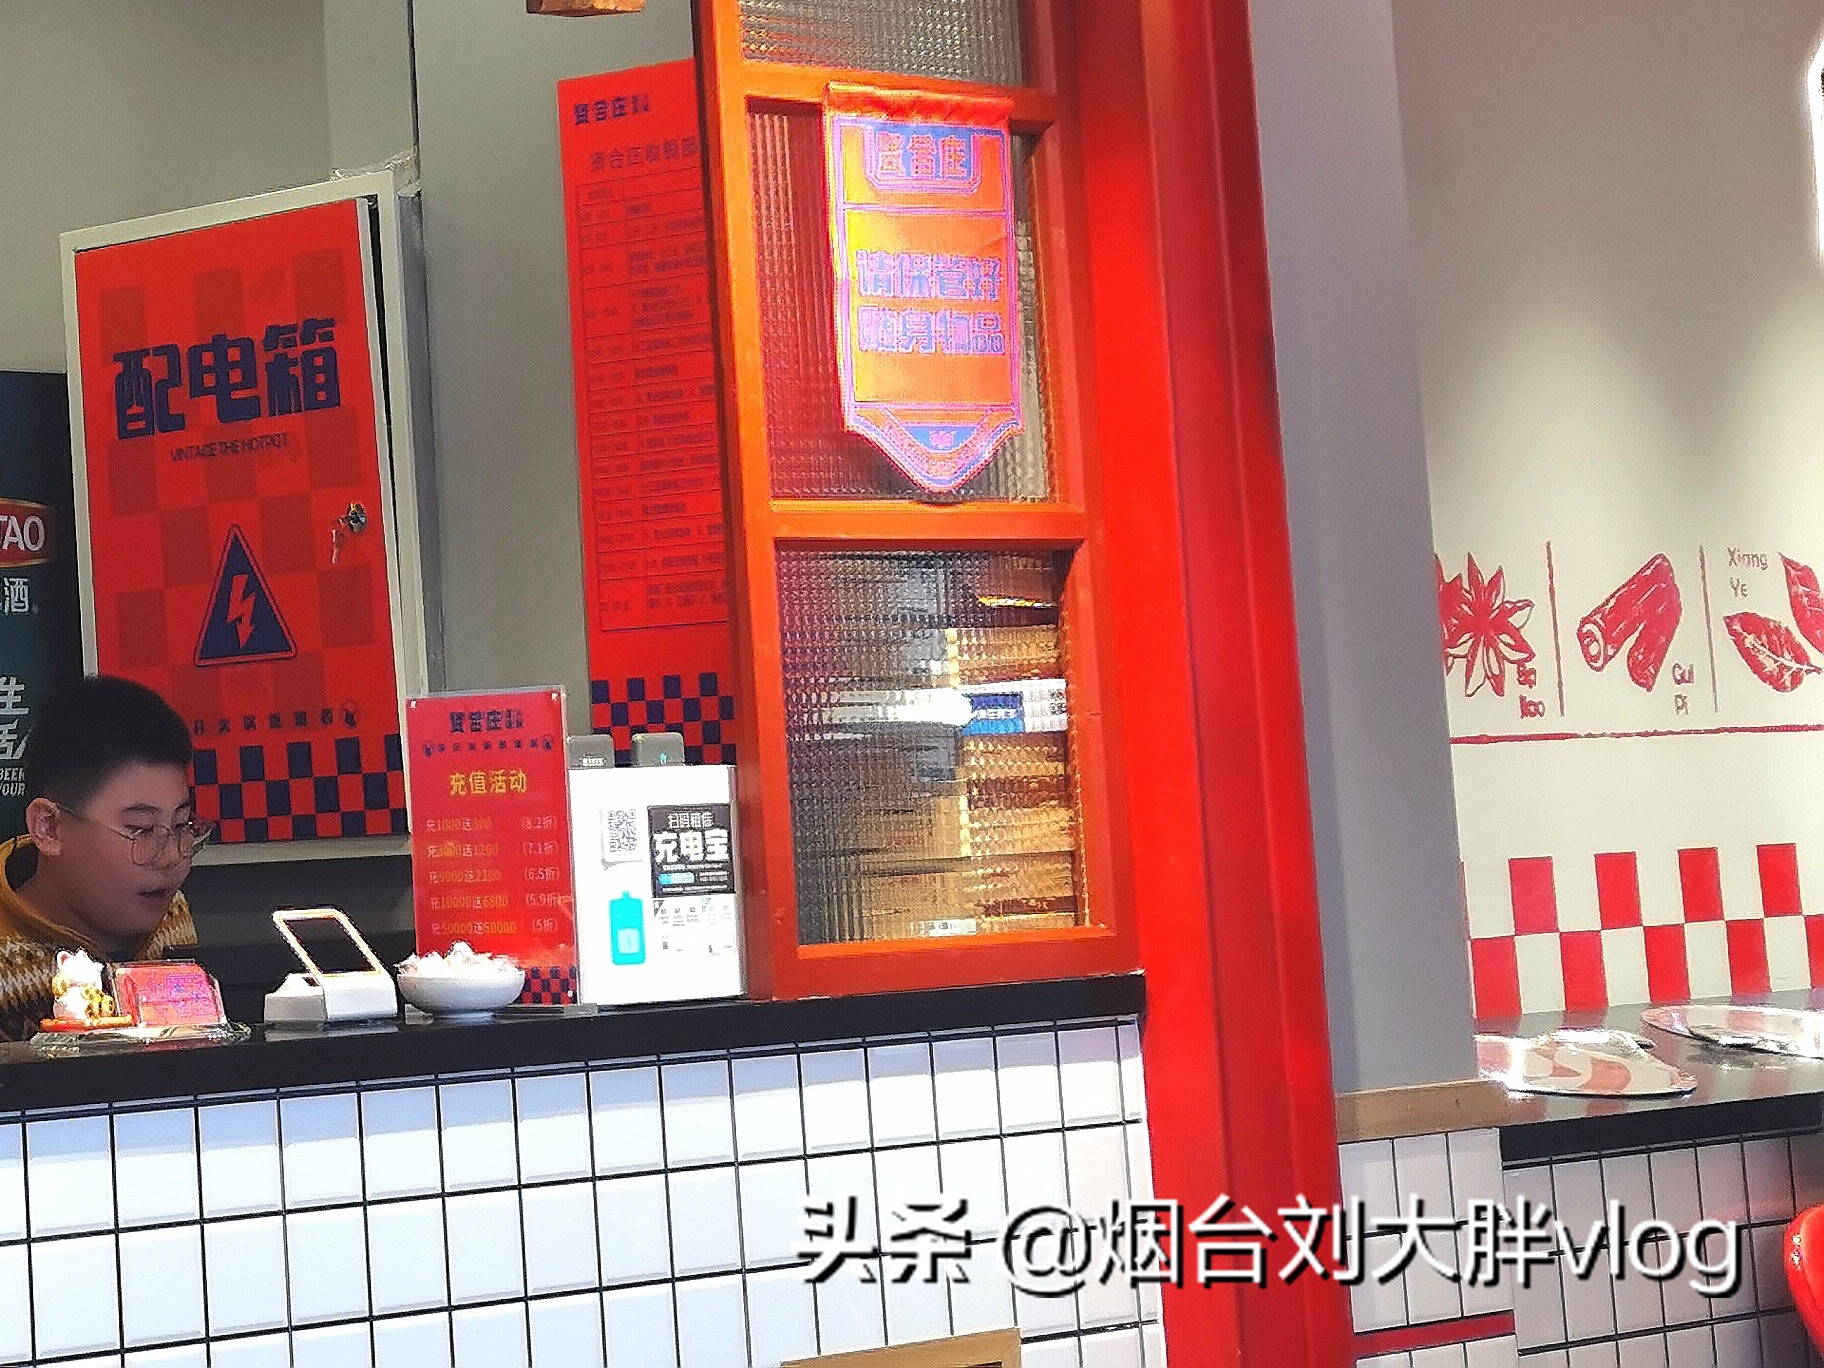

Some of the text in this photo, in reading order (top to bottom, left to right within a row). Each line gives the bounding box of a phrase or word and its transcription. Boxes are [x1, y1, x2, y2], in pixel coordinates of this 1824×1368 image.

[856, 248, 1002, 303] 请保管好
[113, 318, 341, 441] 配电箱
[449, 769, 528, 797] 充值活动
[653, 828, 730, 863] 充电宝
